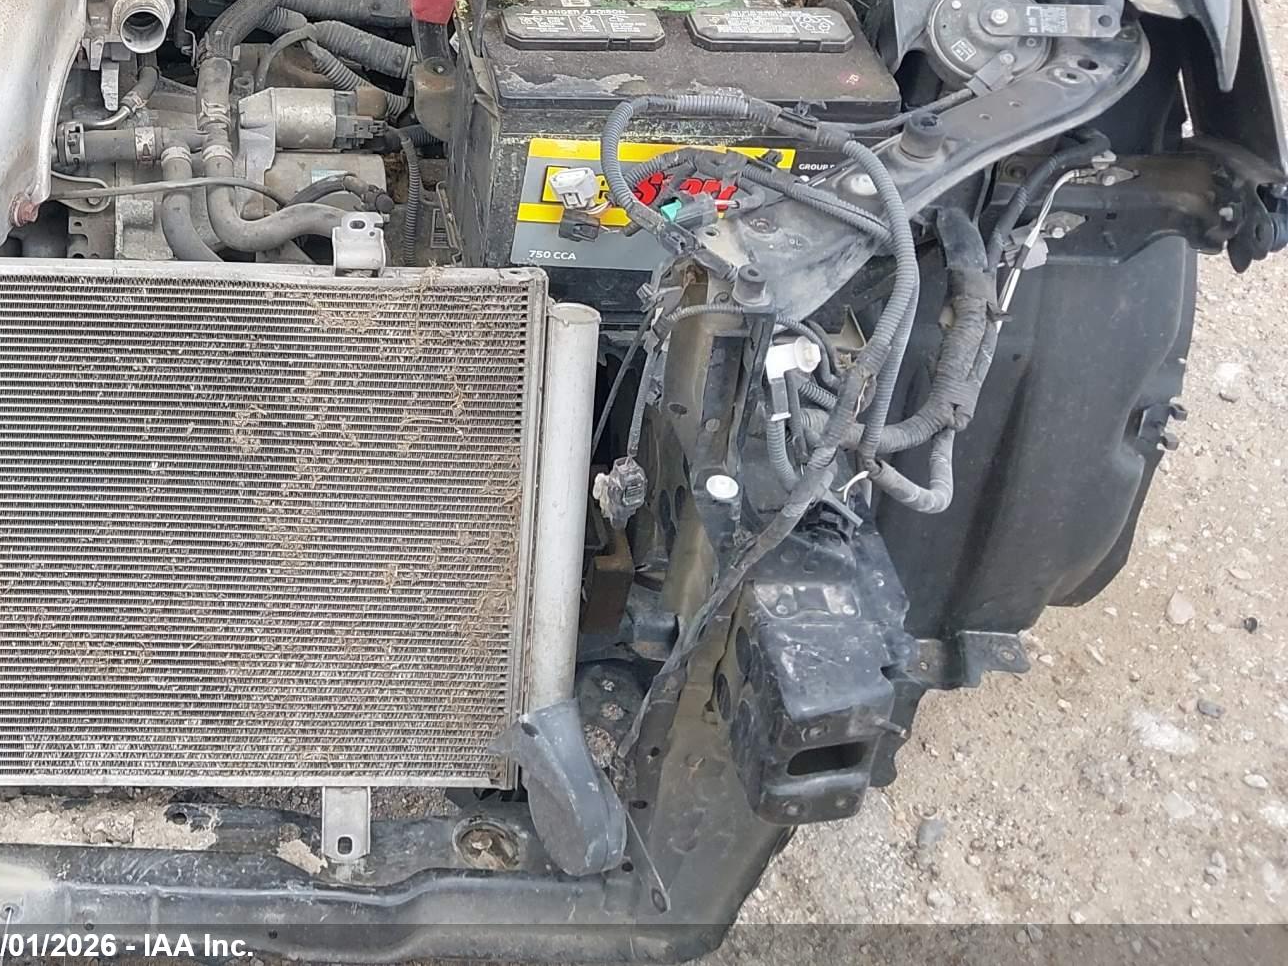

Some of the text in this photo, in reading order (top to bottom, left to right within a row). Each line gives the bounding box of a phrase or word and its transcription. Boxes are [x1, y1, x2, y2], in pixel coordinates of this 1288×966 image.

[798, 163, 829, 171] GROUP
[528, 249, 577, 260] 750 CCA
